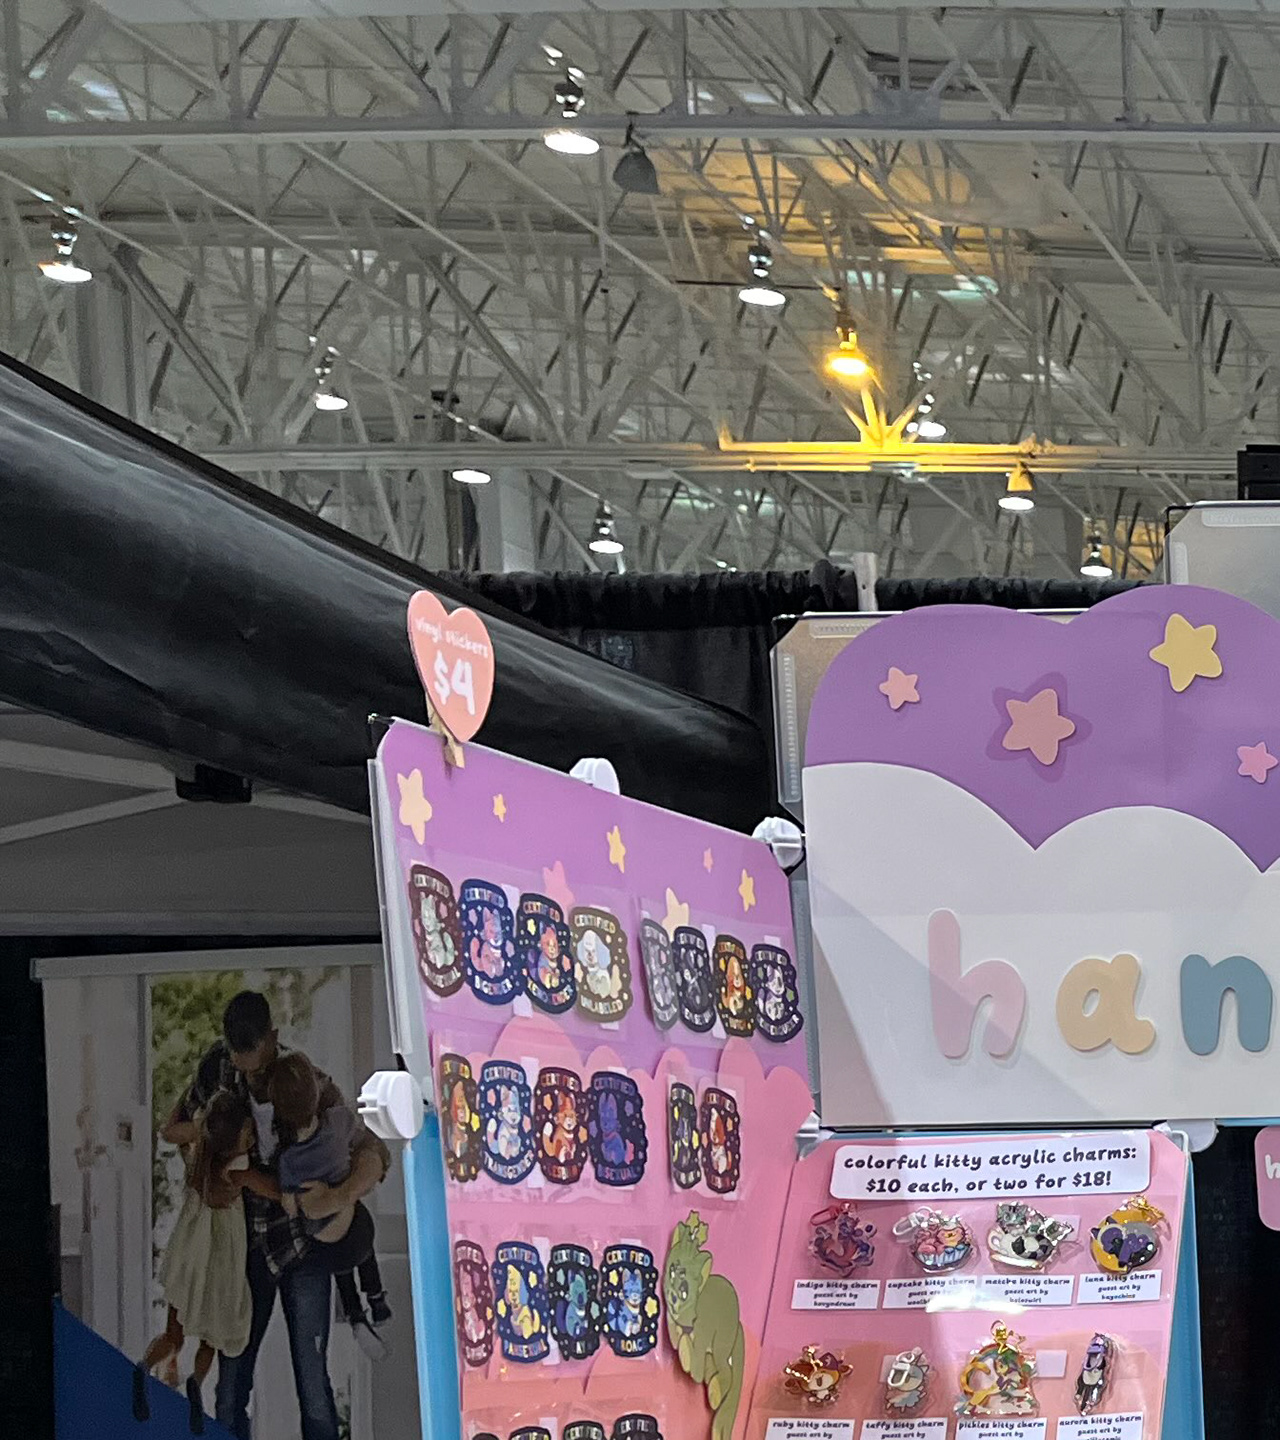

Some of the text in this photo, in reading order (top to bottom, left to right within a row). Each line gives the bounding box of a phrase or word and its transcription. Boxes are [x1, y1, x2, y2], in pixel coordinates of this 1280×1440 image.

[433, 649, 475, 715] $4
[843, 1146, 1137, 1172] colorful kitty acrylic charms:
[865, 1170, 1112, 1194] $10 each, or two for $18!
